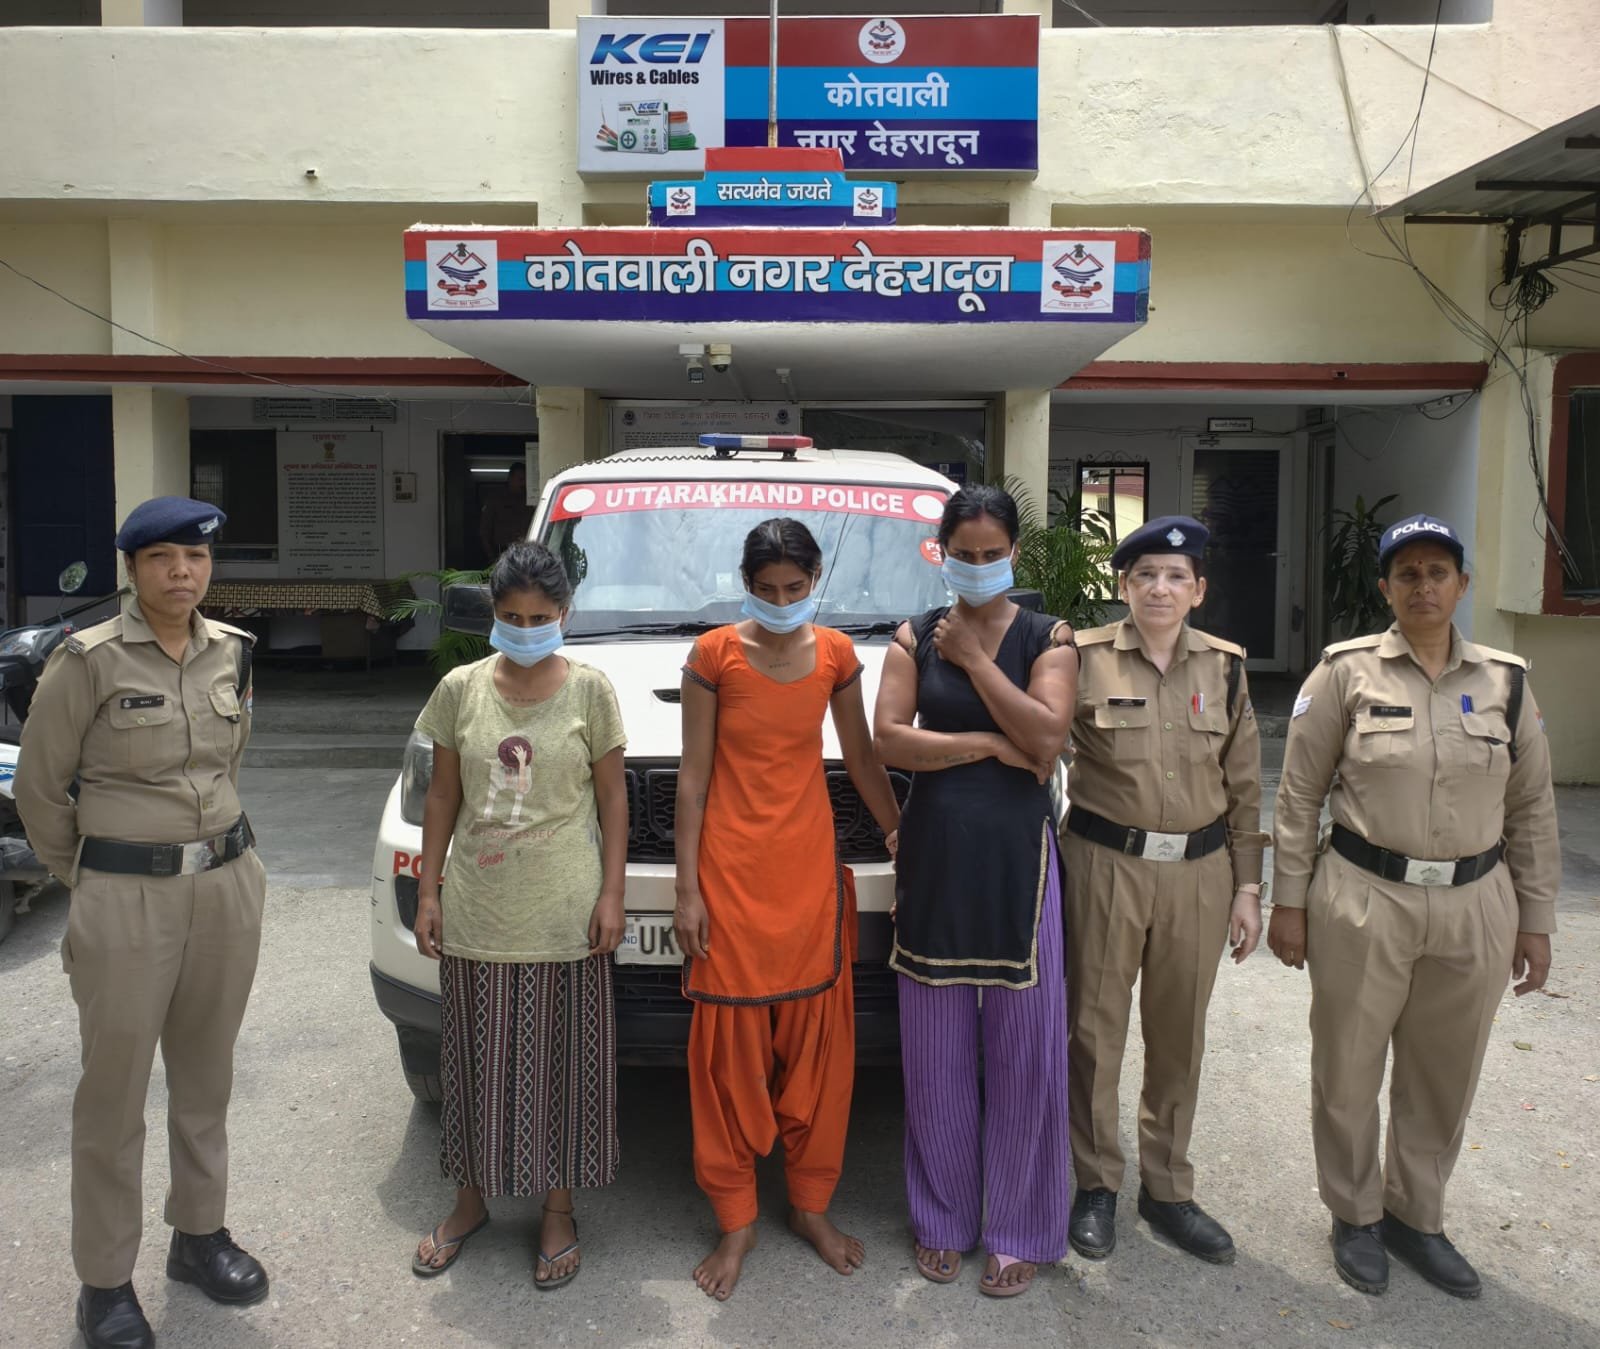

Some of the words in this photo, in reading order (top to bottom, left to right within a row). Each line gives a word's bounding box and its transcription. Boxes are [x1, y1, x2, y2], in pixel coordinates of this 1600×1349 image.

[590, 33, 711, 64] KEI
[590, 70, 633, 85] Wires
[636, 71, 646, 85] &
[649, 69, 699, 85] Cables
[824, 72, 949, 107] कोतवाली
[865, 120, 980, 165] देहरादून
[717, 178, 782, 200] सत्यमेव
[786, 178, 832, 200] जयते
[524, 238, 720, 294] कोतवाली
[727, 254, 836, 293] नगर
[841, 239, 1015, 312] देहरादून
[605, 484, 803, 507] UTTARAKHAND
[812, 487, 904, 513] POLICE
[1392, 521, 1451, 540] POLICE
[623, 935, 638, 945] ND
